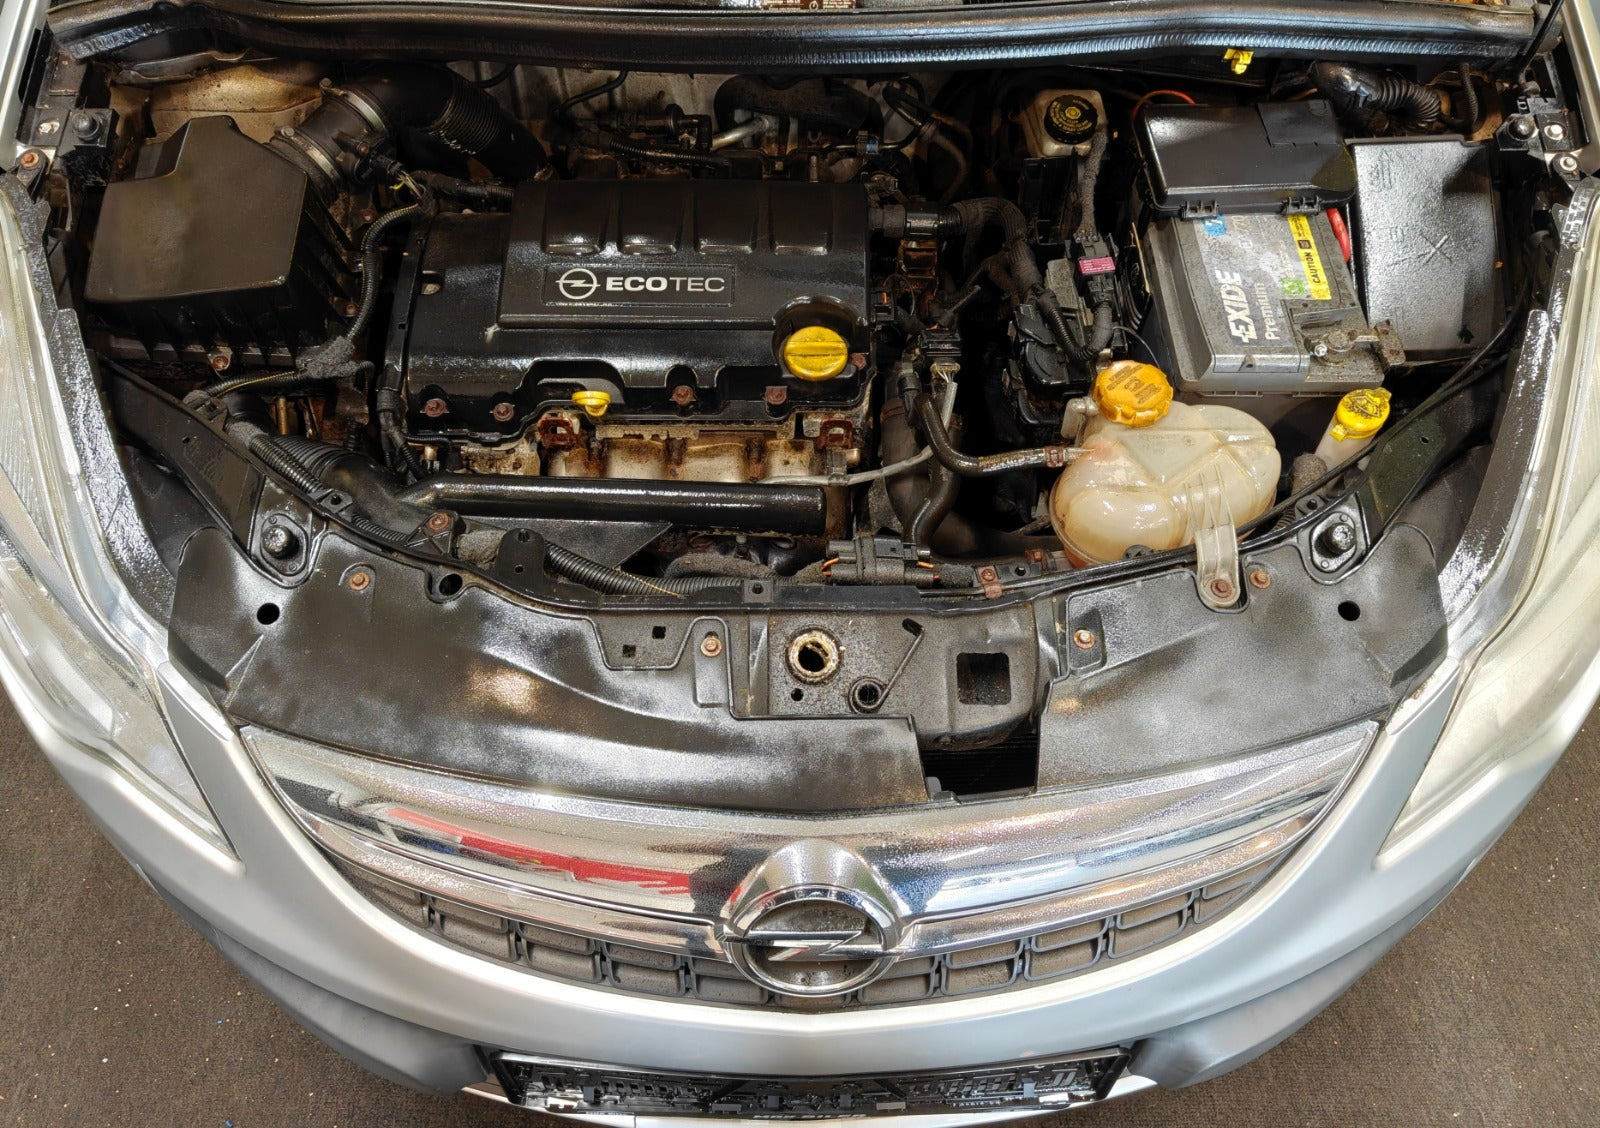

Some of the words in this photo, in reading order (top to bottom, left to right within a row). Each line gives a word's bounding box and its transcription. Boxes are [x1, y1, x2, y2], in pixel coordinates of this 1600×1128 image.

[606, 276, 725, 292] ECOTEC
[1303, 252, 1321, 284] CAUTION
[1214, 269, 1258, 343] EXIDE
[1253, 282, 1280, 341] Premium
